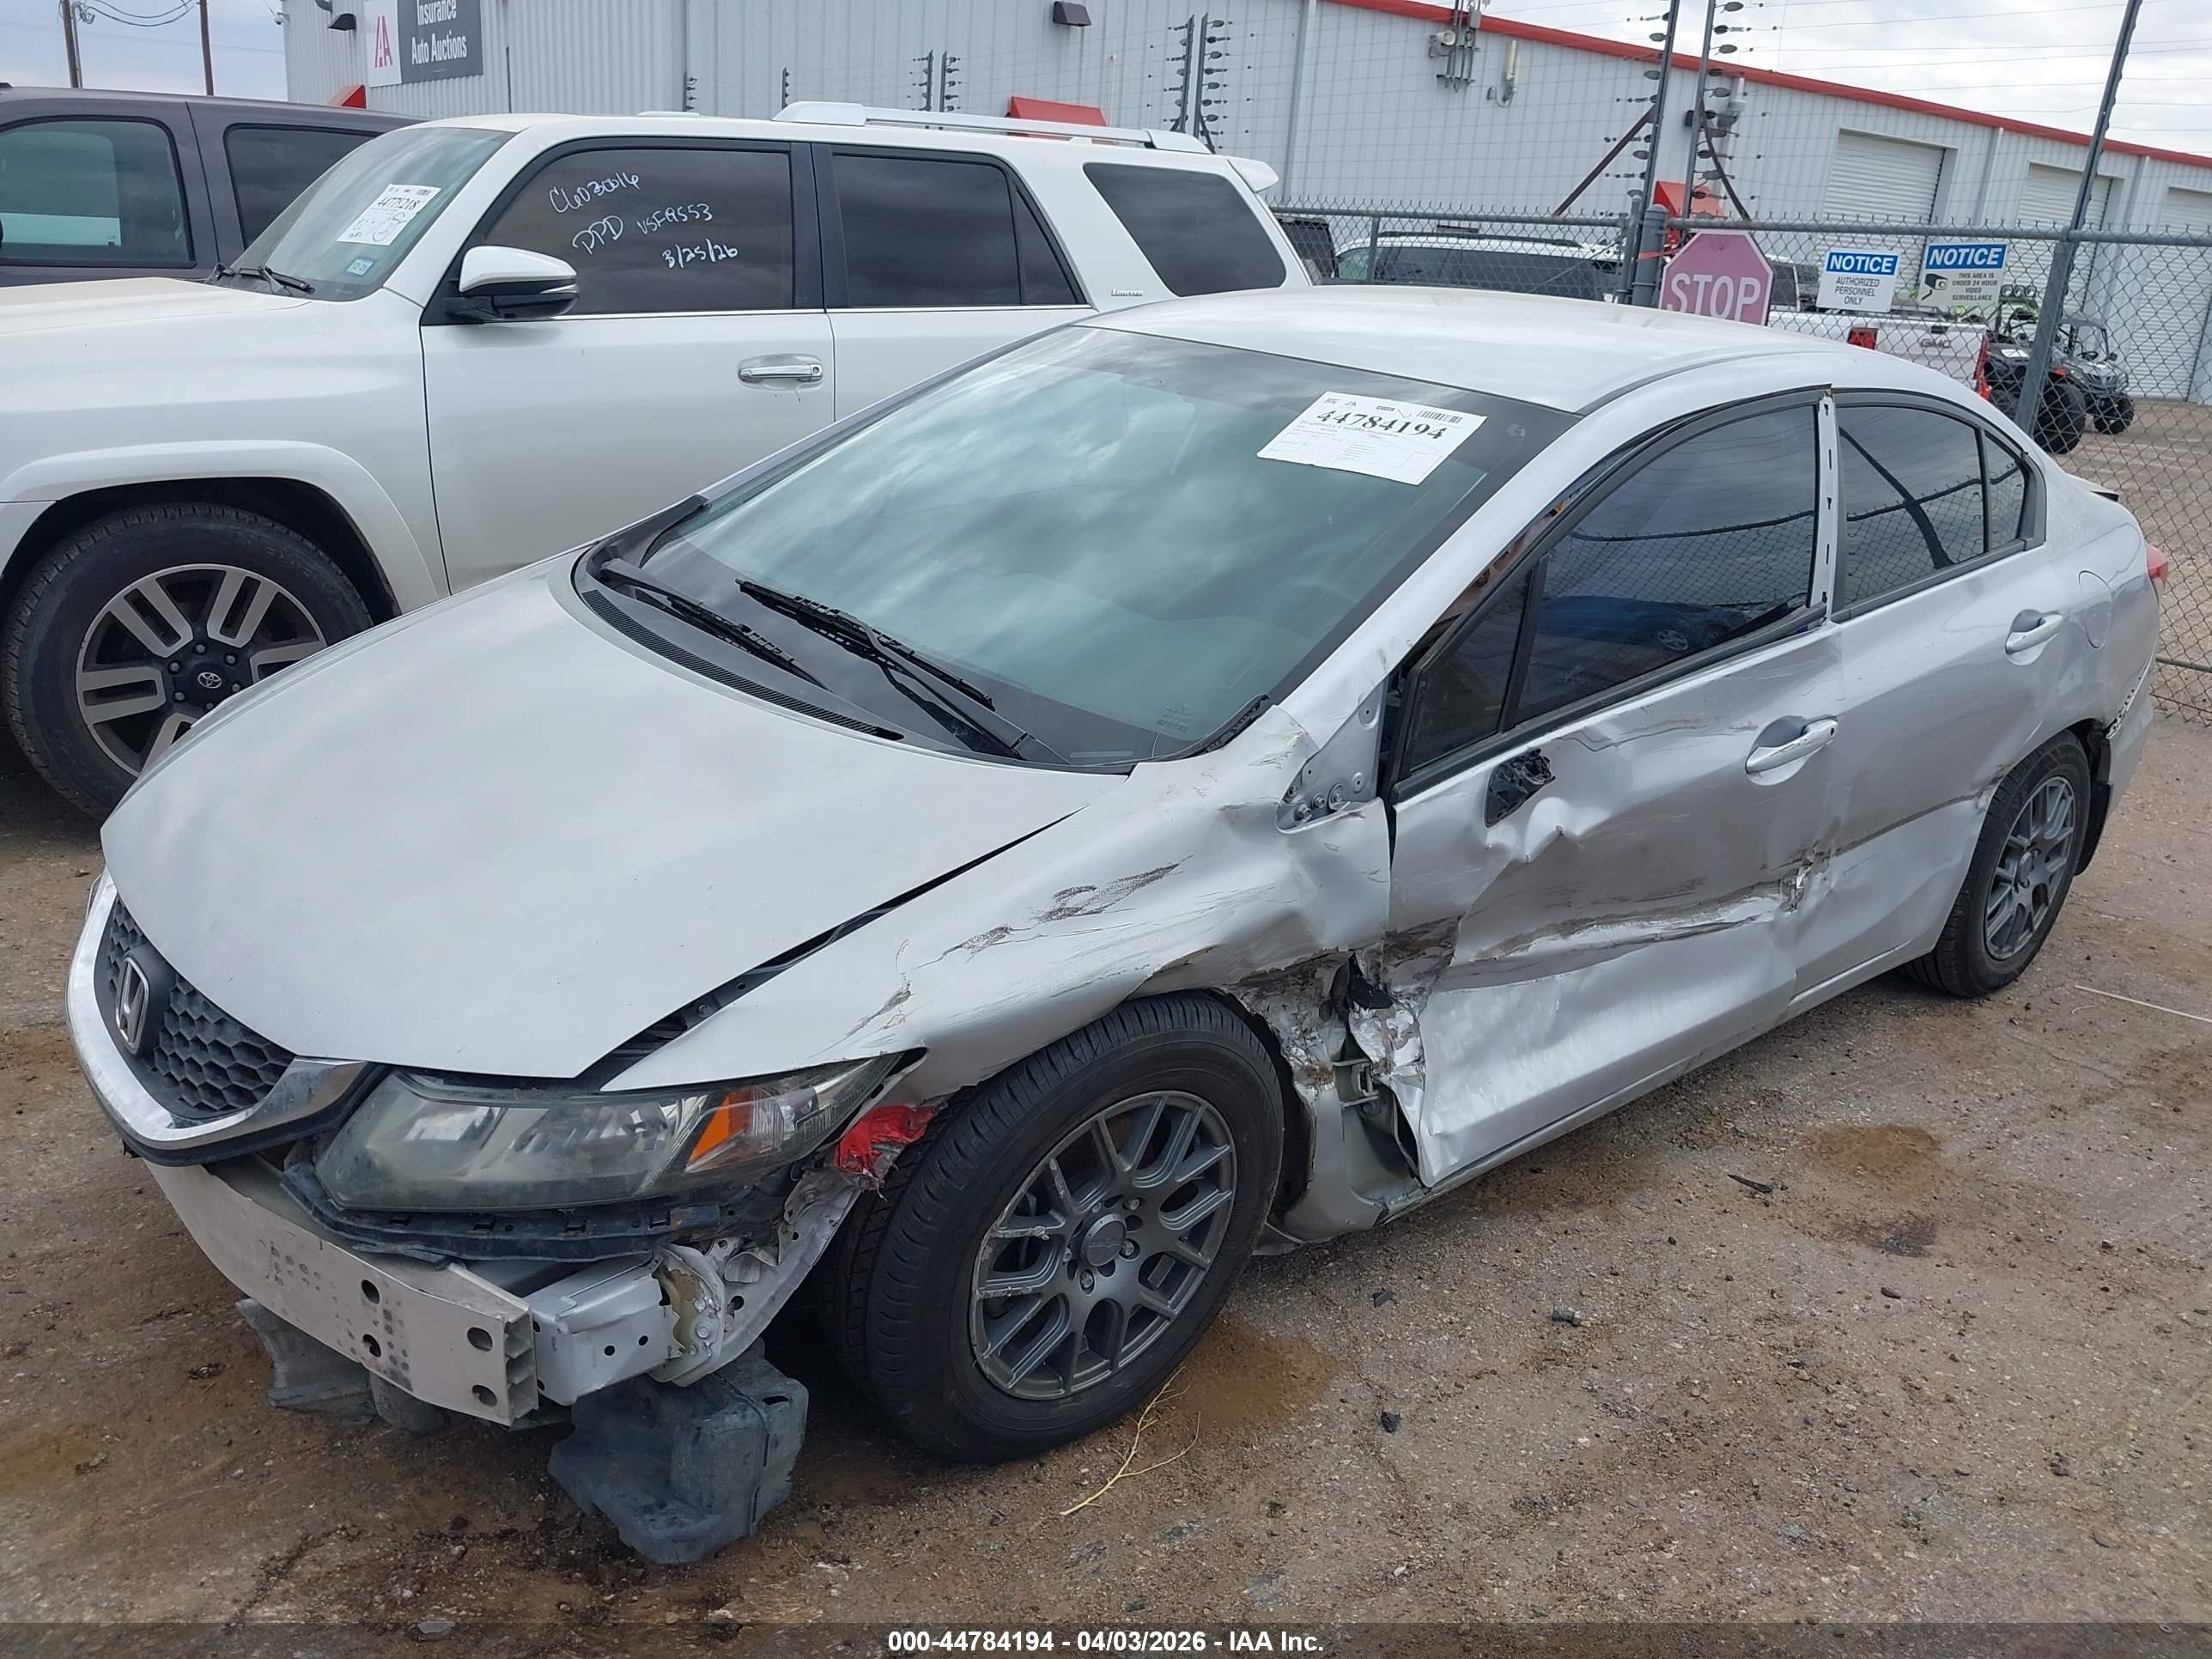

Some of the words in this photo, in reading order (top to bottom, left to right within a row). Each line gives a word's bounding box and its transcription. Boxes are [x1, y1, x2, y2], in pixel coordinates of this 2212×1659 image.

[416, 0, 457, 27] Insurance
[411, 36, 429, 65] Auto
[431, 29, 468, 63] Auctions
[1829, 254, 1894, 274] NOTICE
[1928, 247, 2002, 266] NOTICE
[1834, 286, 1875, 297] PERSONNEL
[1835, 276, 1881, 288] AUTHORIZED
[1666, 272, 1761, 322] STOP
[1844, 295, 1863, 306] ONLY
[1316, 410, 1448, 440] 44784194
